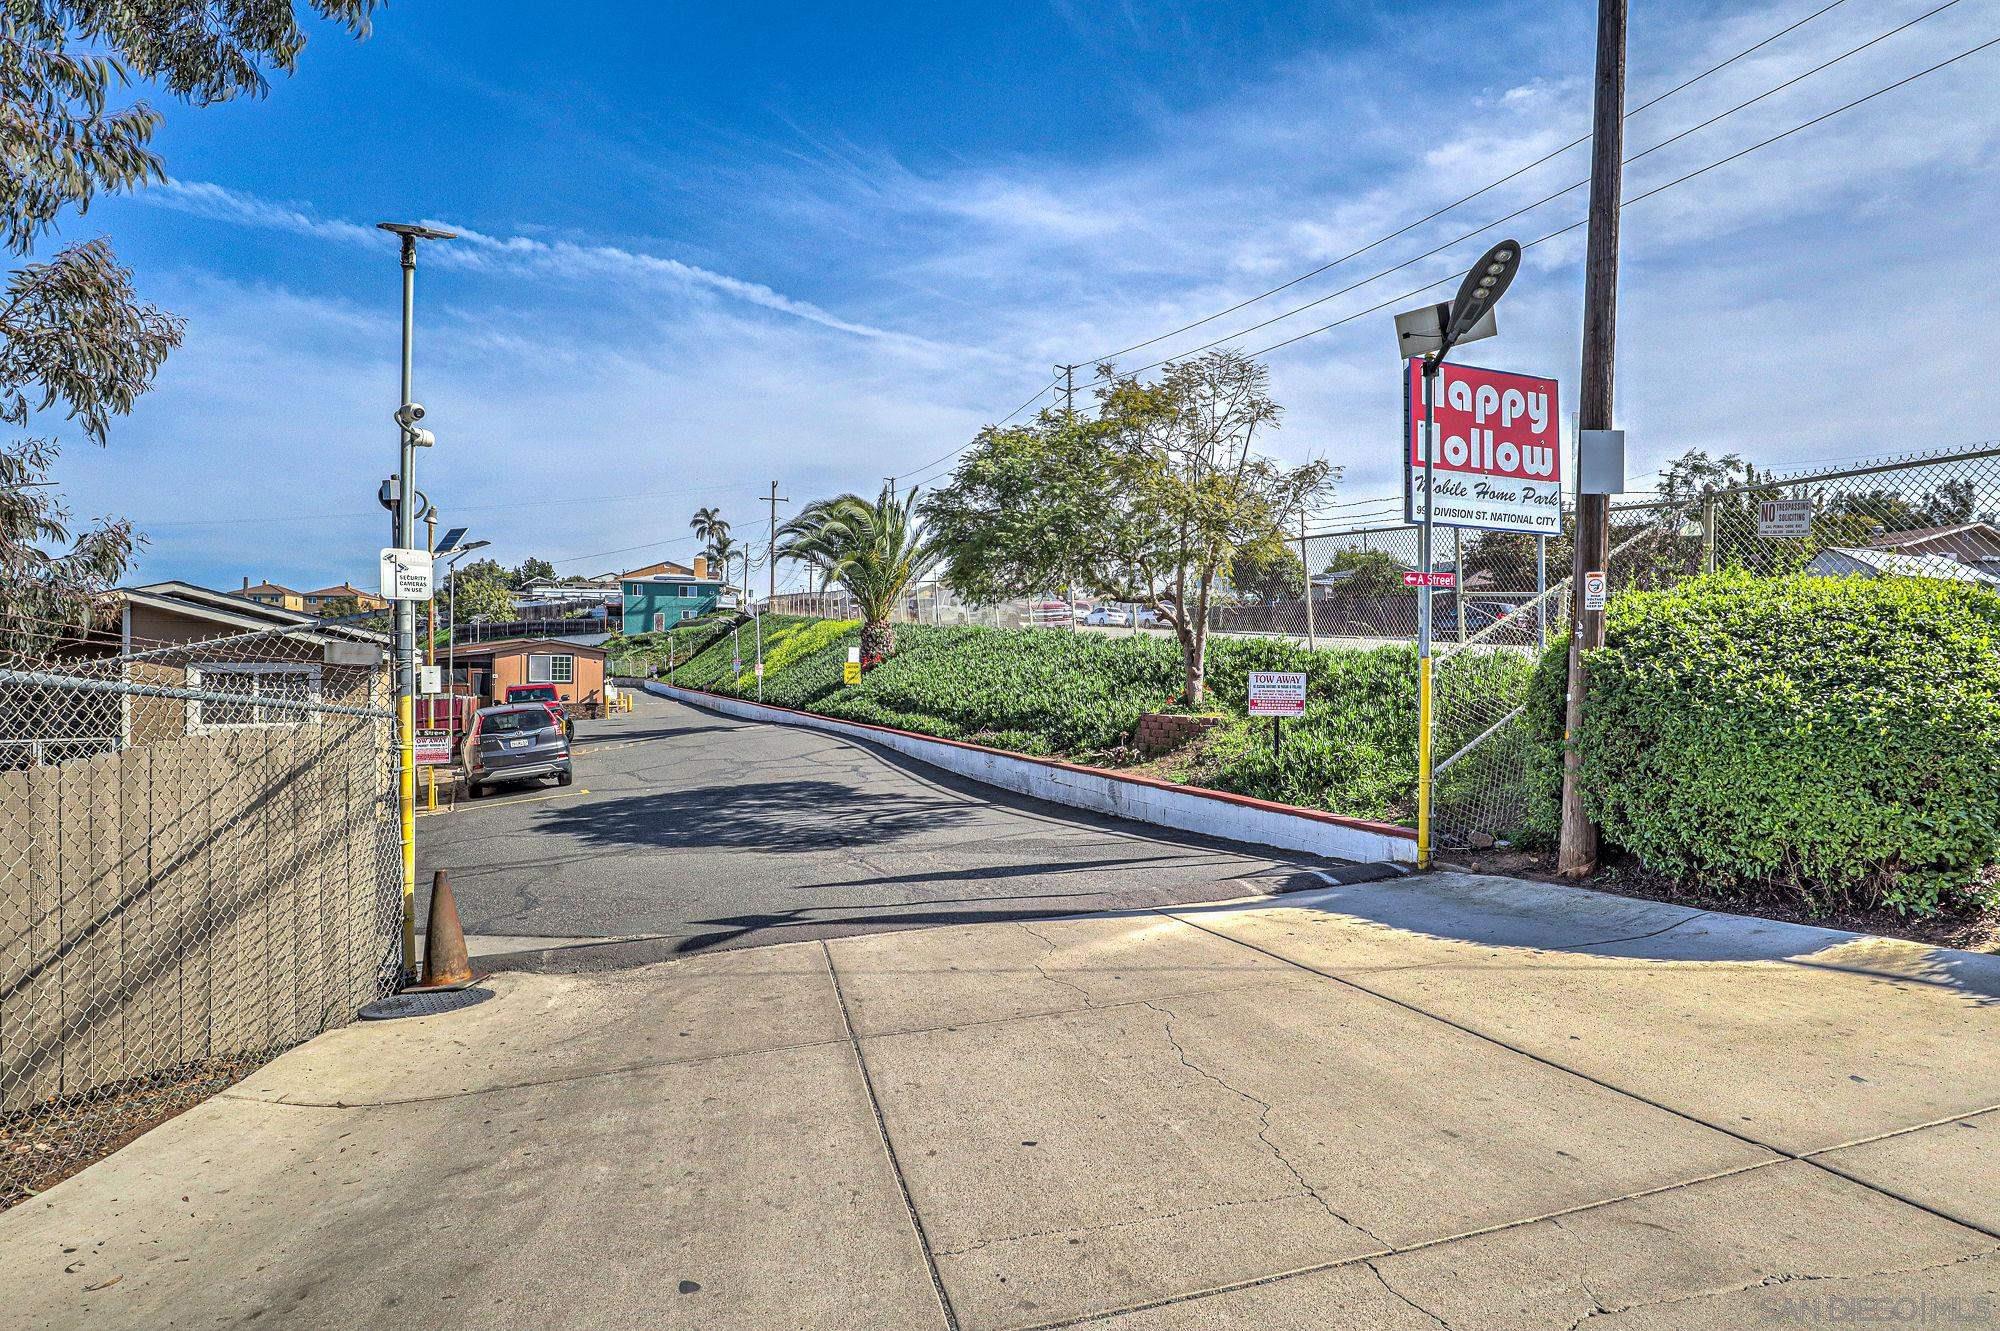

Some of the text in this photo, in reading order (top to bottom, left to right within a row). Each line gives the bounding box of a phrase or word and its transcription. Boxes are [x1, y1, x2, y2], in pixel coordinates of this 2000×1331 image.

[1421, 365, 1548, 434] Happy
[1417, 420, 1553, 477] Hollow
[1474, 482, 1517, 502] Home
[1522, 487, 1559, 507] Park
[1761, 503, 1776, 522] NO
[1776, 502, 1809, 511] TRESPASSING
[1433, 507, 1473, 520] DIVISION
[1475, 511, 1488, 521] ST.
[1490, 512, 1534, 525] NATIONAL
[1536, 516, 1557, 527] CITY
[1778, 514, 1806, 522] SOLICITING
[1418, 574, 1454, 586] A Street
[1254, 675, 1302, 684] TOW AWAY
